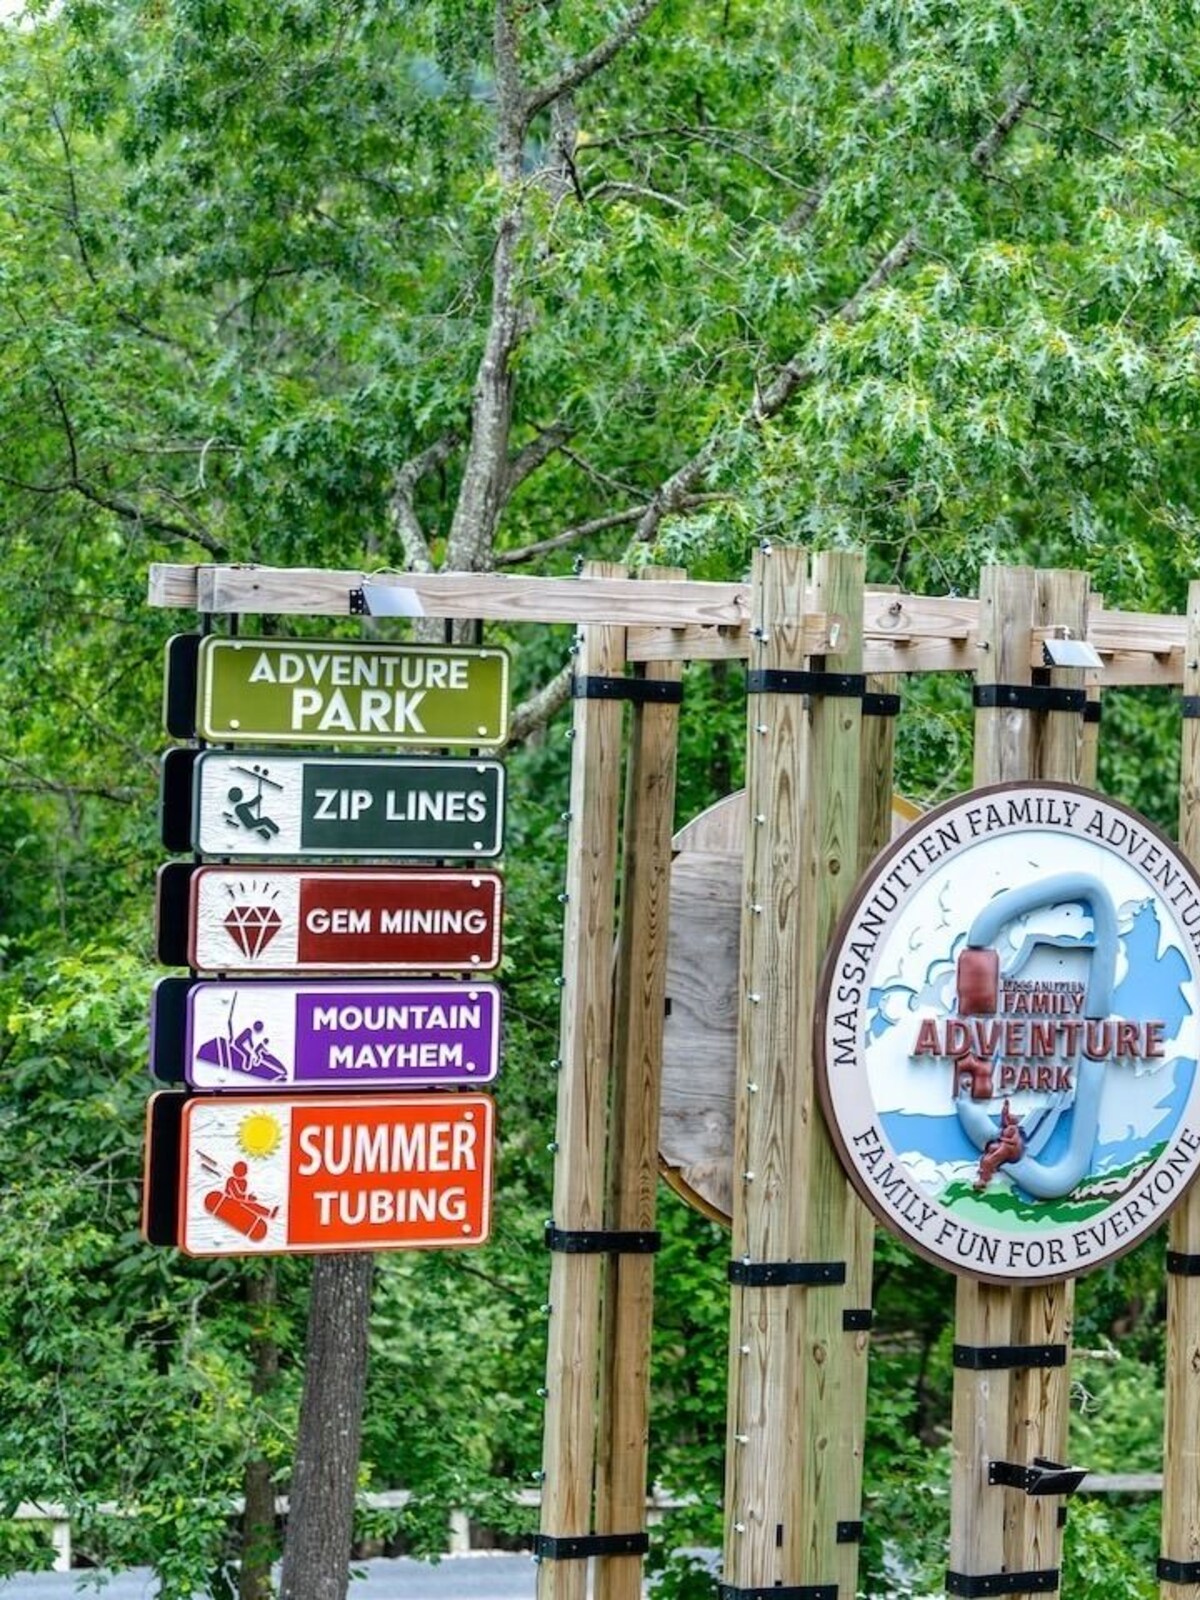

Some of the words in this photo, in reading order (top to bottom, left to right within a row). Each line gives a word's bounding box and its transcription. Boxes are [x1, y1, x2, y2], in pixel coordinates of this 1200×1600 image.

[249, 652, 469, 690] ADVENTURE
[291, 687, 427, 734] PARK
[313, 789, 373, 820] ZIP
[386, 790, 487, 823] LINES
[306, 908, 369, 934] GEM
[380, 909, 487, 936] MINING
[833, 826, 963, 1067] MASSANUTTEN
[965, 797, 1081, 837] FAMILY
[312, 1005, 481, 1031] MOUNTAIN
[1001, 992, 1085, 1015] FAMILY
[328, 1043, 463, 1069] MAYHEM
[914, 1018, 1166, 1060] ADVENTURE
[1000, 1066, 1073, 1092] PARK
[298, 1122, 477, 1177] SUMMER
[314, 1187, 467, 1226] TUBING
[852, 1126, 939, 1233] FAMILY
[934, 1219, 999, 1264] FUN
[1005, 1240, 1067, 1268] FOR
